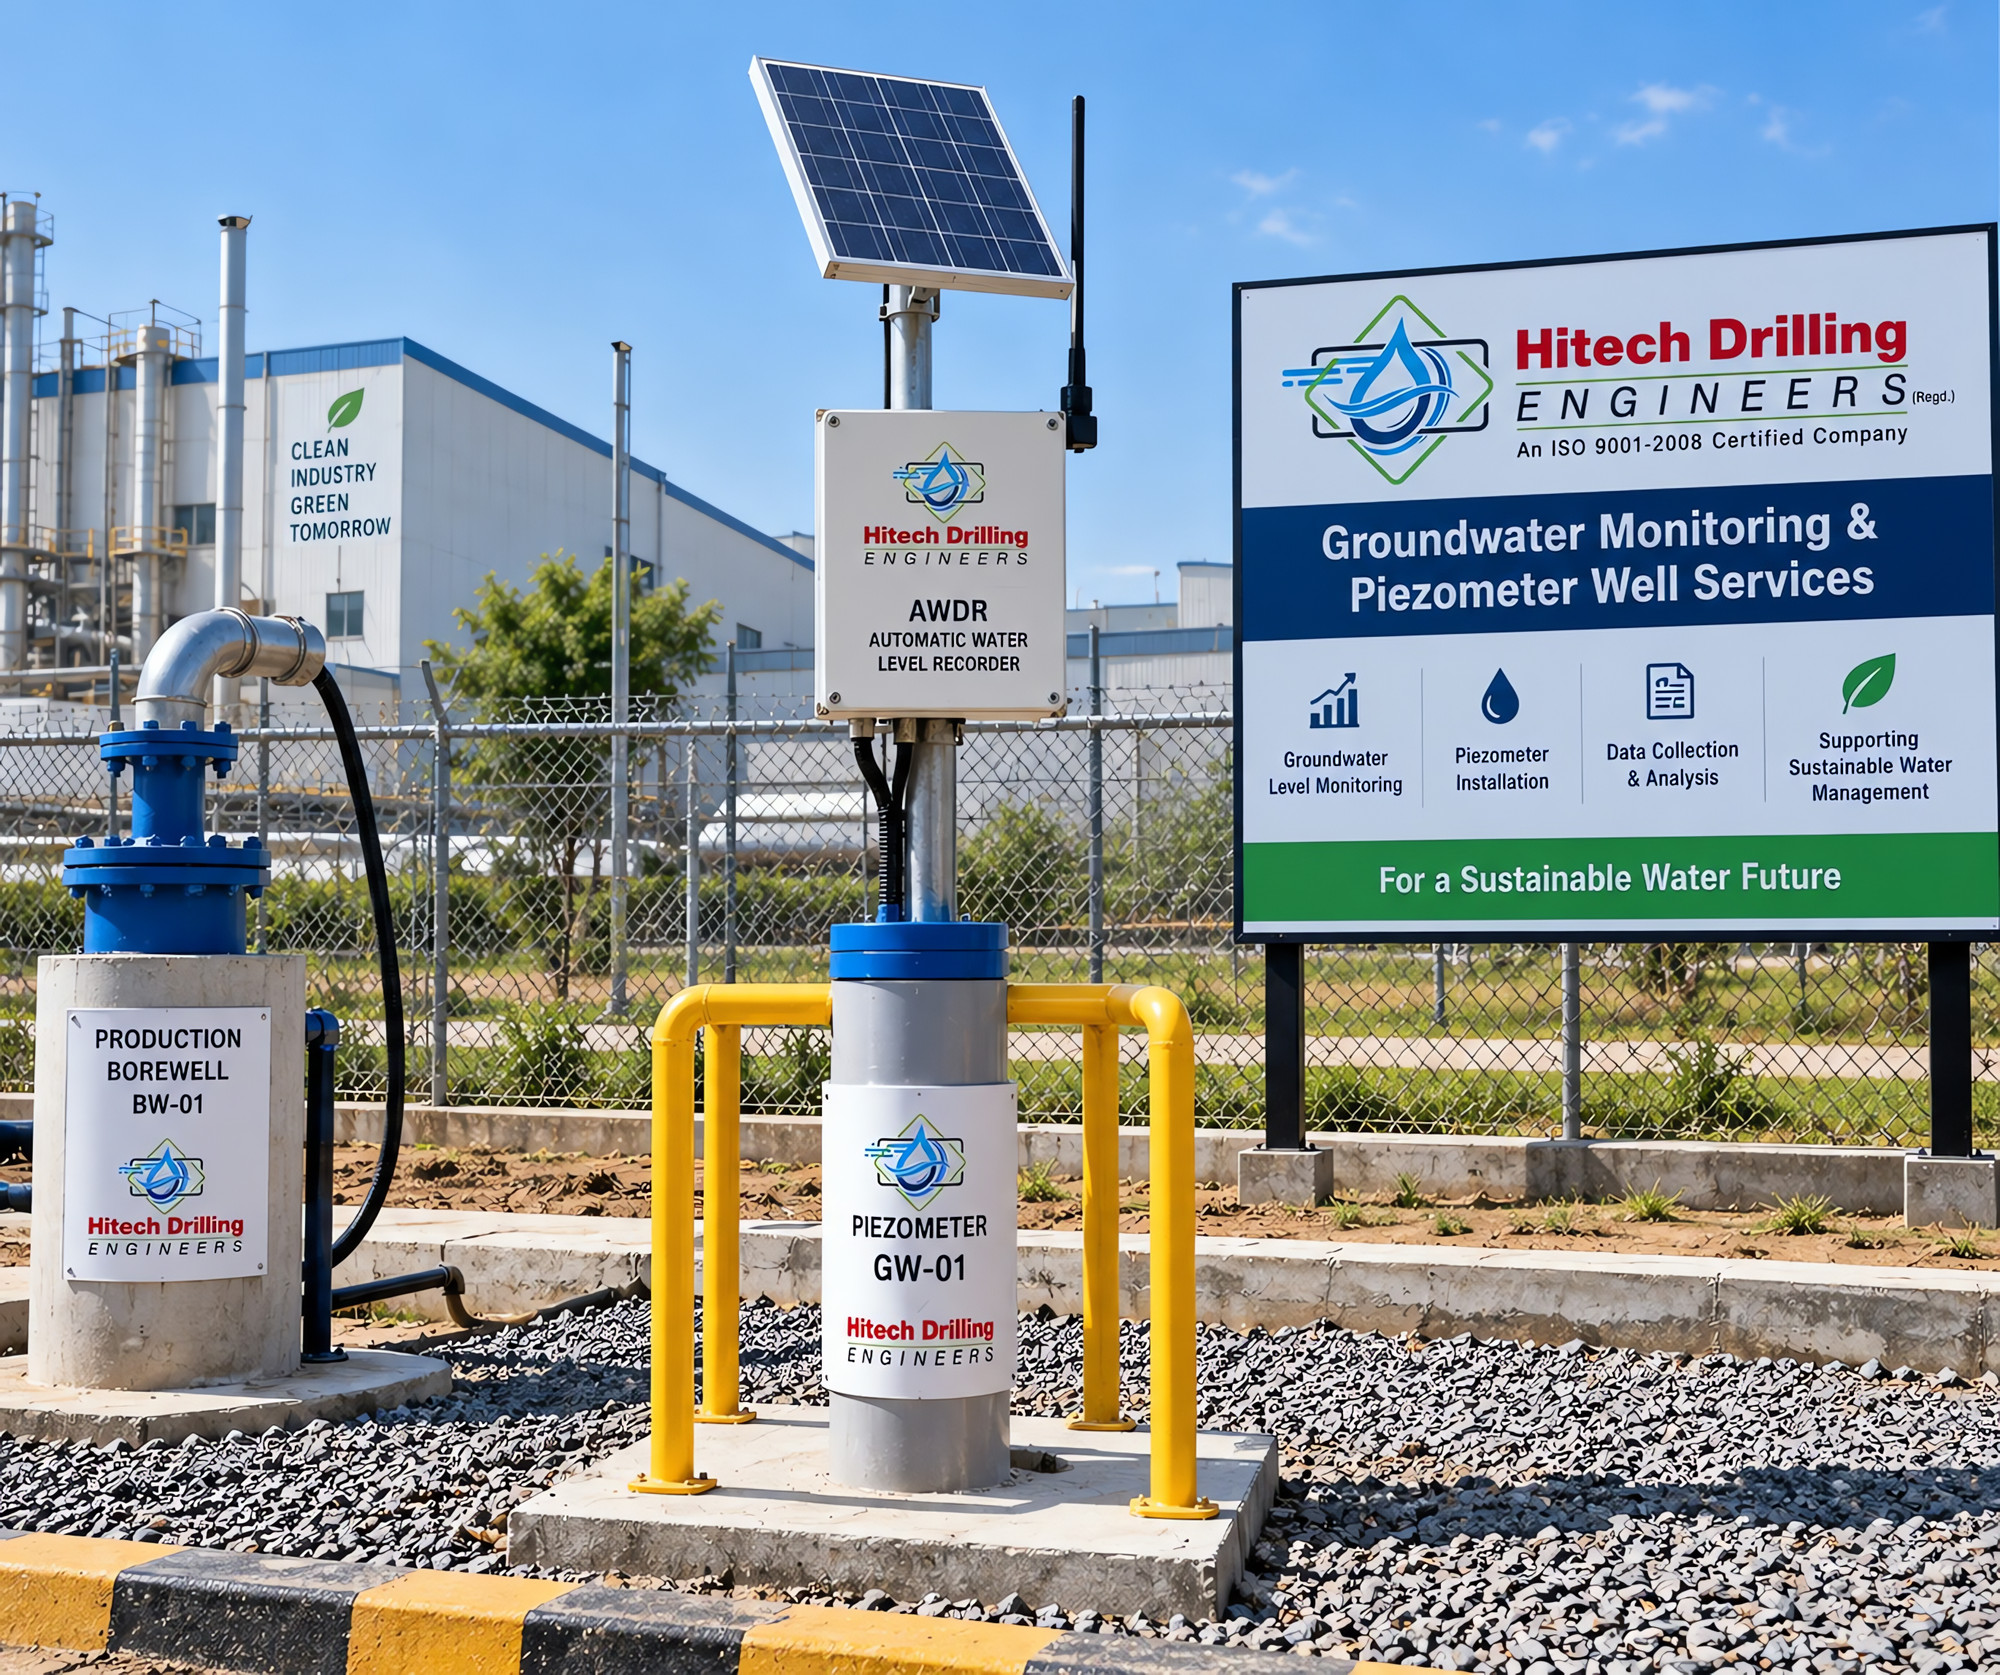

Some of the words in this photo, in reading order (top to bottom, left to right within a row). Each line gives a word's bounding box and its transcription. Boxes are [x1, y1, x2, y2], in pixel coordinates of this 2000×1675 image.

[1517, 322, 1690, 370] Hitech
[1710, 312, 1906, 363] Drilling
[1517, 374, 1907, 422] ENGINEERS
[1913, 390, 1954, 405] (Regd.)
[292, 438, 348, 460] CLEAN
[1517, 442, 1541, 458] An
[1553, 439, 1585, 456] ISO
[1596, 434, 1701, 454] 9001-2008
[1713, 428, 1803, 449] Certified
[1814, 428, 1907, 446] Company
[292, 463, 376, 487] INDUSTRY
[291, 493, 348, 514] GREEN
[290, 517, 391, 542] TOMORROW
[864, 526, 939, 544] Hitech
[947, 526, 1028, 548] Drilling
[1323, 519, 1585, 560] Groundwater
[1601, 507, 1829, 551] Monitoring
[1847, 503, 1878, 540] &
[864, 552, 1028, 565] ENGINEERS
[1352, 573, 1578, 612] Piezometer
[1591, 565, 1677, 603] Well
[1694, 560, 1874, 600] Services
[909, 600, 987, 622] AWDR
[869, 632, 966, 647] AUTOMATIC
[972, 632, 1027, 647] WATER
[879, 656, 928, 671] LEVEL
[934, 656, 1020, 671] RECORDER
[1608, 744, 1645, 760] Data
[1653, 741, 1738, 759] Collection
[1820, 730, 1918, 753] Supporting
[1284, 751, 1388, 767] Groundwater
[1456, 747, 1549, 763] Piezometer
[1790, 757, 1893, 775] Sustainable
[1900, 757, 1952, 773] Water
[1270, 777, 1309, 794] Level
[1317, 776, 1402, 796] Monitoring
[1457, 773, 1548, 790] Installation
[1628, 770, 1639, 787] &
[1646, 768, 1718, 790] Analysis
[1813, 784, 1929, 804] Management
[1381, 867, 1425, 893] For
[1435, 873, 1450, 892] a
[1461, 864, 1631, 892] Sustainable
[1642, 863, 1730, 891] Water
[1743, 863, 1841, 889] Future
[96, 1029, 240, 1048] PRODUCTION
[108, 1061, 229, 1081] BOREWELL
[133, 1094, 202, 1114] BW-01
[89, 1217, 160, 1235] Hitech
[168, 1216, 243, 1237] Drilling
[853, 1215, 986, 1239] PIEZOMETER
[88, 1240, 243, 1255] ENGINEERS
[874, 1254, 964, 1281] GW-01
[848, 1317, 914, 1340] Hitech
[923, 1318, 993, 1341] Drilling
[847, 1346, 993, 1366] ENGINEERS
